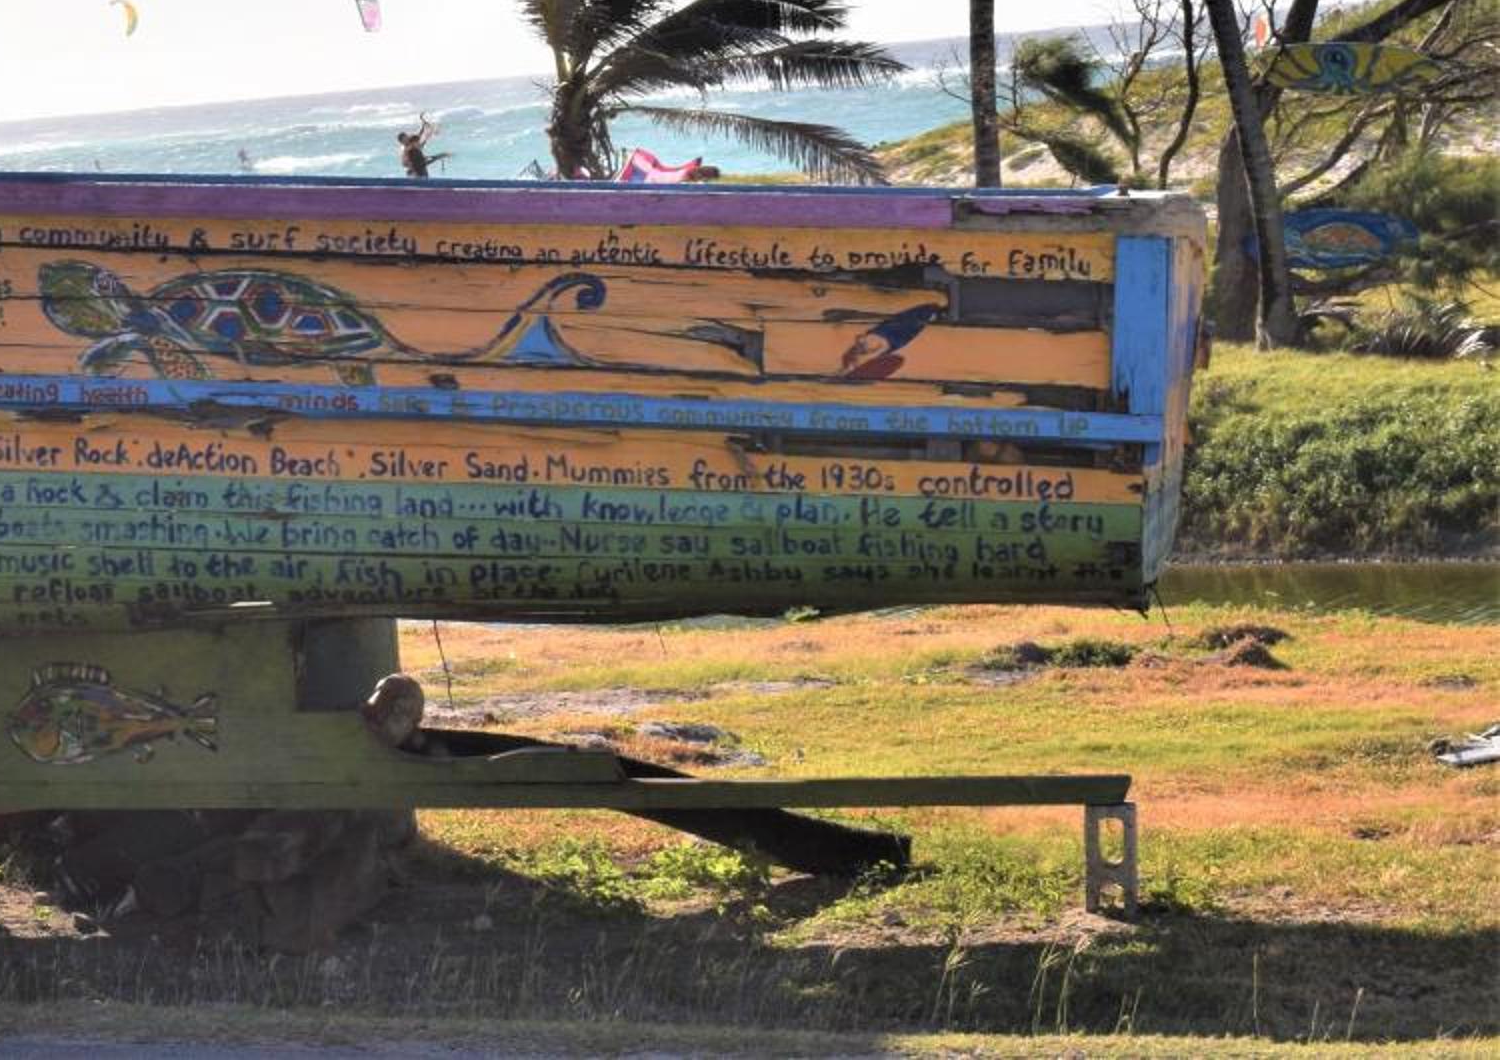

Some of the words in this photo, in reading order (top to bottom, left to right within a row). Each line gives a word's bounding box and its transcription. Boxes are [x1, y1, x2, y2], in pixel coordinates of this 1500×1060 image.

[18, 224, 170, 258] community
[231, 228, 301, 251] surf
[316, 229, 418, 255] society
[436, 238, 523, 270] creating
[536, 247, 560, 263] an
[808, 246, 835, 268] to
[688, 459, 748, 489] from
[764, 462, 806, 490] the
[820, 465, 895, 491] 1930s
[918, 465, 1075, 499] controlled
[0, 482, 15, 502] a
[494, 489, 563, 519] with
[917, 501, 976, 529] tell
[990, 509, 1009, 531] a
[1020, 504, 1105, 535] story
[453, 528, 479, 550] of
[204, 553, 259, 579] the
[423, 561, 459, 587] in
